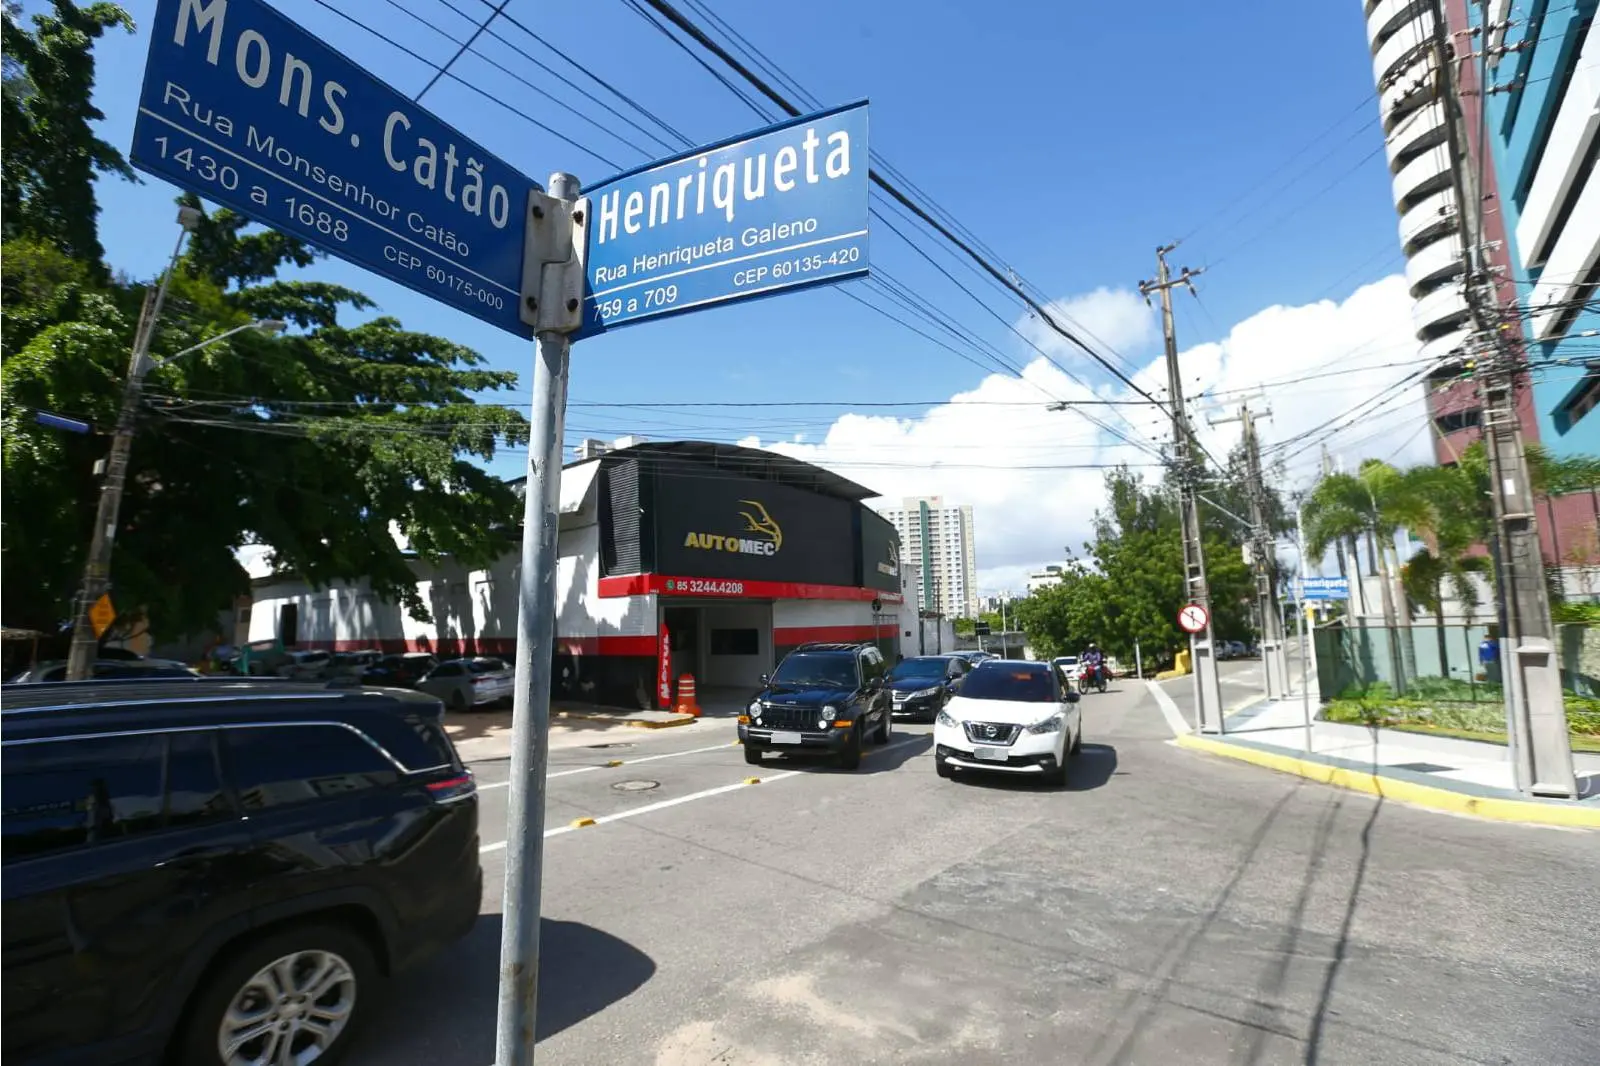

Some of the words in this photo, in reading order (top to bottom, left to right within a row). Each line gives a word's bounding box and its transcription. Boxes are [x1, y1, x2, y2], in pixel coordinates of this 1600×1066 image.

[173, 0, 360, 147] Mons.
[383, 110, 509, 229] Catão
[155, 137, 239, 191] 1430
[250, 185, 268, 206] a
[285, 197, 349, 243] 1688
[163, 81, 233, 138] Rua
[246, 125, 401, 220] Monsenhor
[407, 212, 470, 257] Catão
[598, 127, 851, 244] Henriqueta
[384, 245, 423, 271] CEP
[426, 265, 503, 310] 60175-000
[595, 266, 628, 285] Rua
[633, 234, 734, 273] Henriqueta
[741, 218, 818, 248] Galeno
[733, 267, 768, 286] CEP
[772, 247, 860, 279] 60135-420
[593, 297, 622, 321] 759
[627, 298, 638, 312] a
[644, 285, 677, 309] 709
[684, 531, 775, 556] AUTOMEC
[676, 580, 688, 591] 85
[689, 580, 744, 593] 3244.4208
